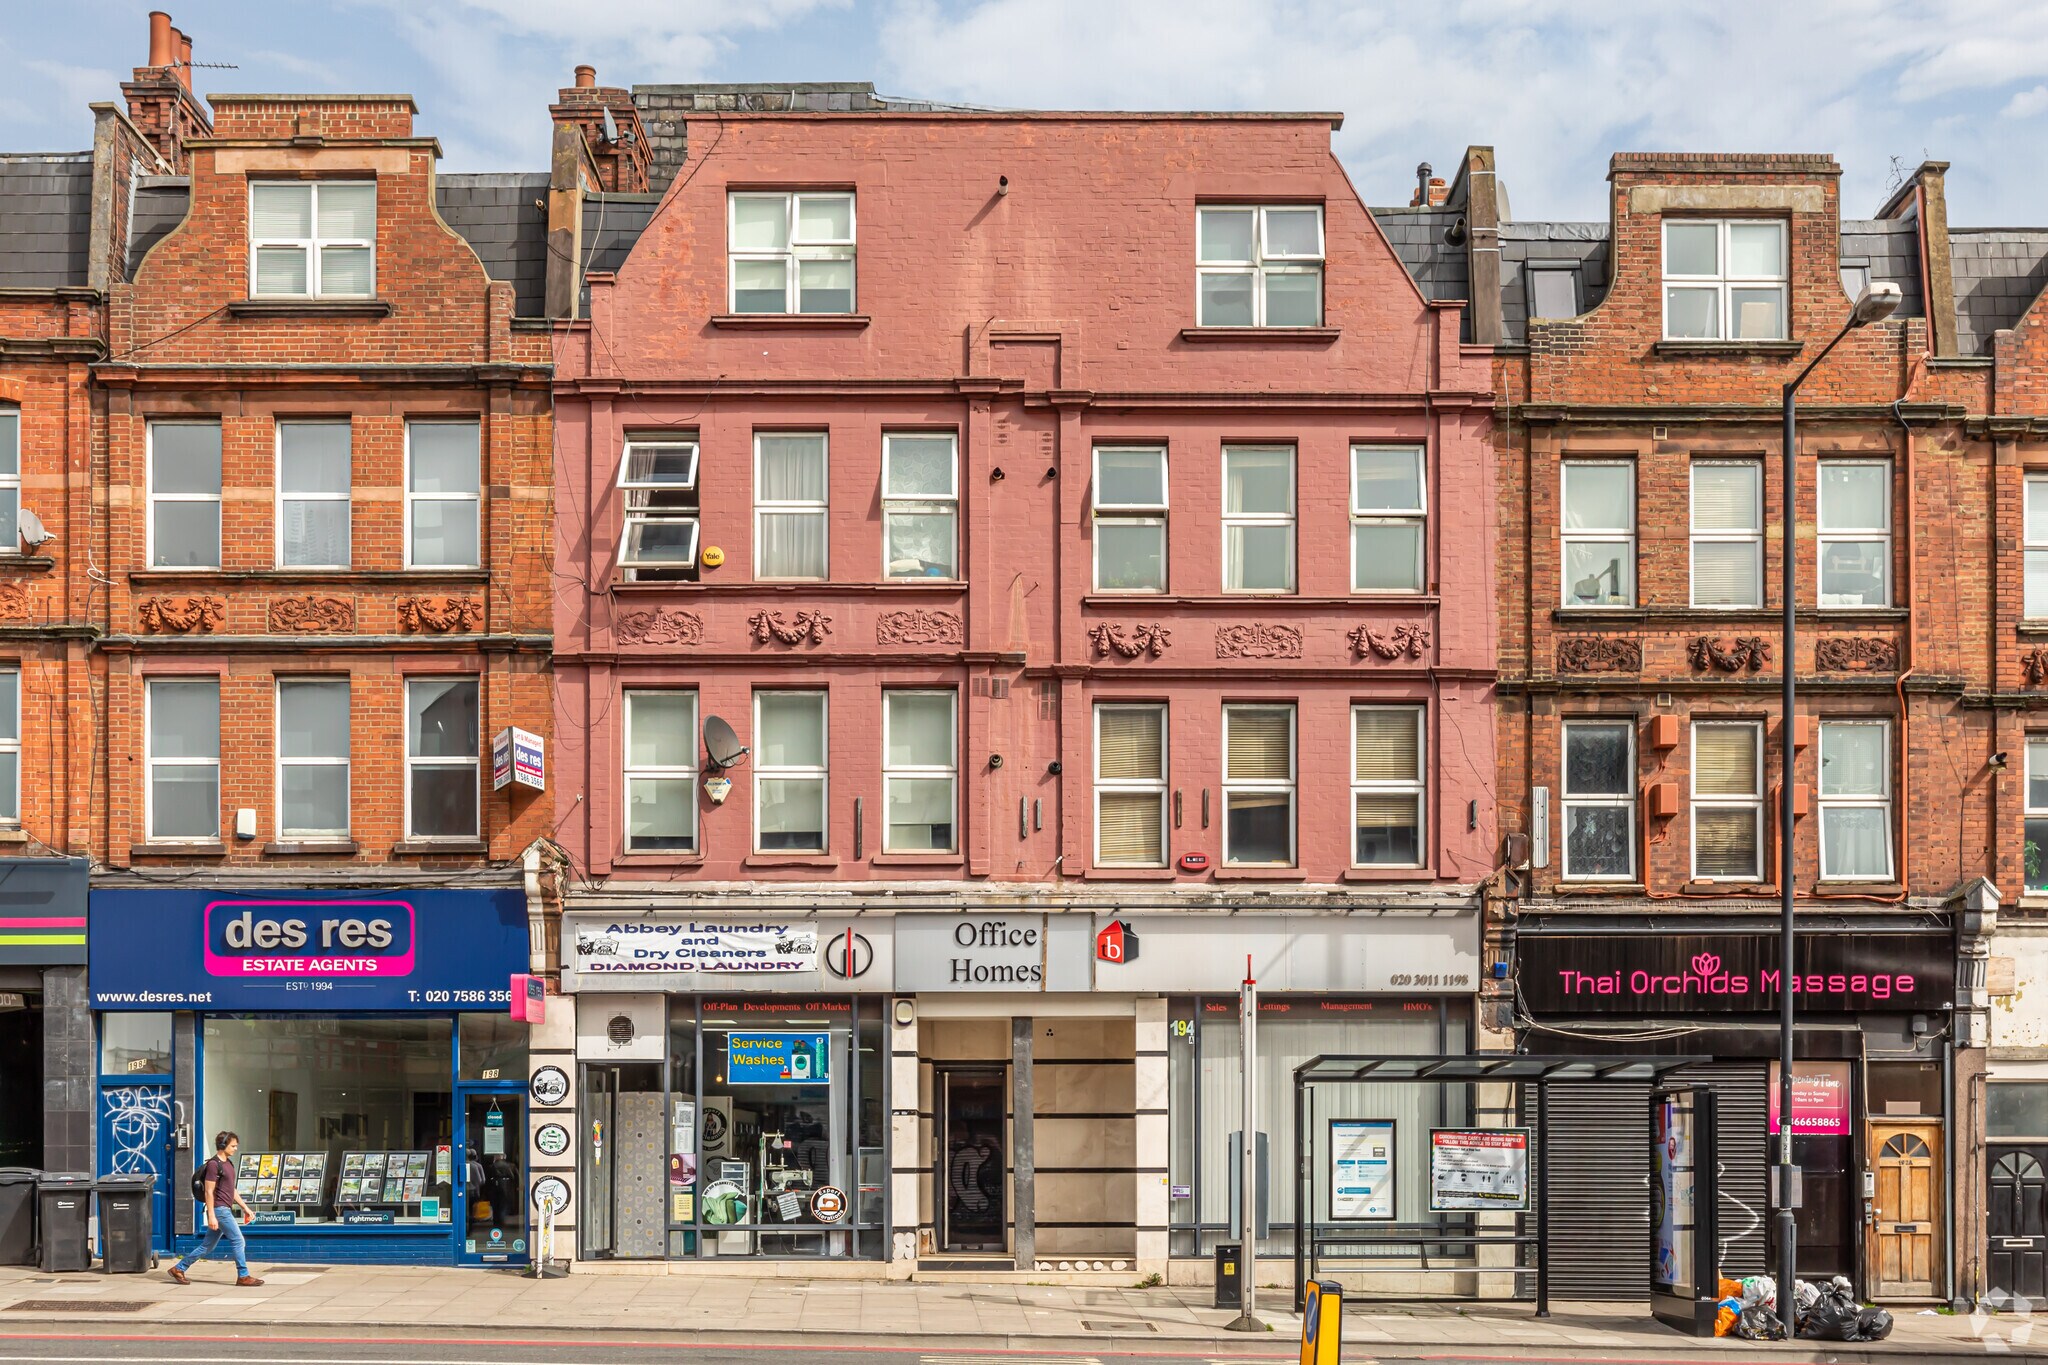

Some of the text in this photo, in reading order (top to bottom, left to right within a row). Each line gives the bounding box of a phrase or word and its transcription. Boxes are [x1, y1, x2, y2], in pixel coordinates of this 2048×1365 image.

[705, 552, 720, 560] Yale
[516, 746, 541, 768] des res
[225, 911, 393, 949] des res
[605, 923, 788, 935] Abbey Laundry
[955, 921, 1037, 946] Office
[681, 936, 719, 945] and
[634, 948, 766, 959] Dry Cleaners
[243, 958, 378, 972] ESTATE AGENTS
[590, 961, 804, 971] DIAMOND LAUNDRY
[950, 958, 1042, 982] Homes
[1390, 974, 1412, 986] 020
[1413, 974, 1439, 986] 3011
[1559, 970, 1621, 994] Thai
[1630, 970, 1748, 994] Orchids
[311, 982, 333, 991] 1994
[96, 990, 212, 1003] www.desres.net
[408, 990, 420, 1002] T:
[425, 990, 449, 1002] 020
[453, 990, 486, 1002] 7586
[703, 1002, 850, 1013] Off-Plan Developments Off Market
[1206, 1002, 1432, 1012] Sales Lettings Management HMO's
[1170, 1020, 1195, 1036] 194
[732, 1037, 783, 1049] Service
[732, 1053, 785, 1065] Washes
[483, 1069, 499, 1079] 198
[1815, 1073, 1842, 1088] Time
[818, 1188, 841, 1196] Expert
[349, 1214, 382, 1223] rightmove
[814, 1209, 844, 1221] Alterations
